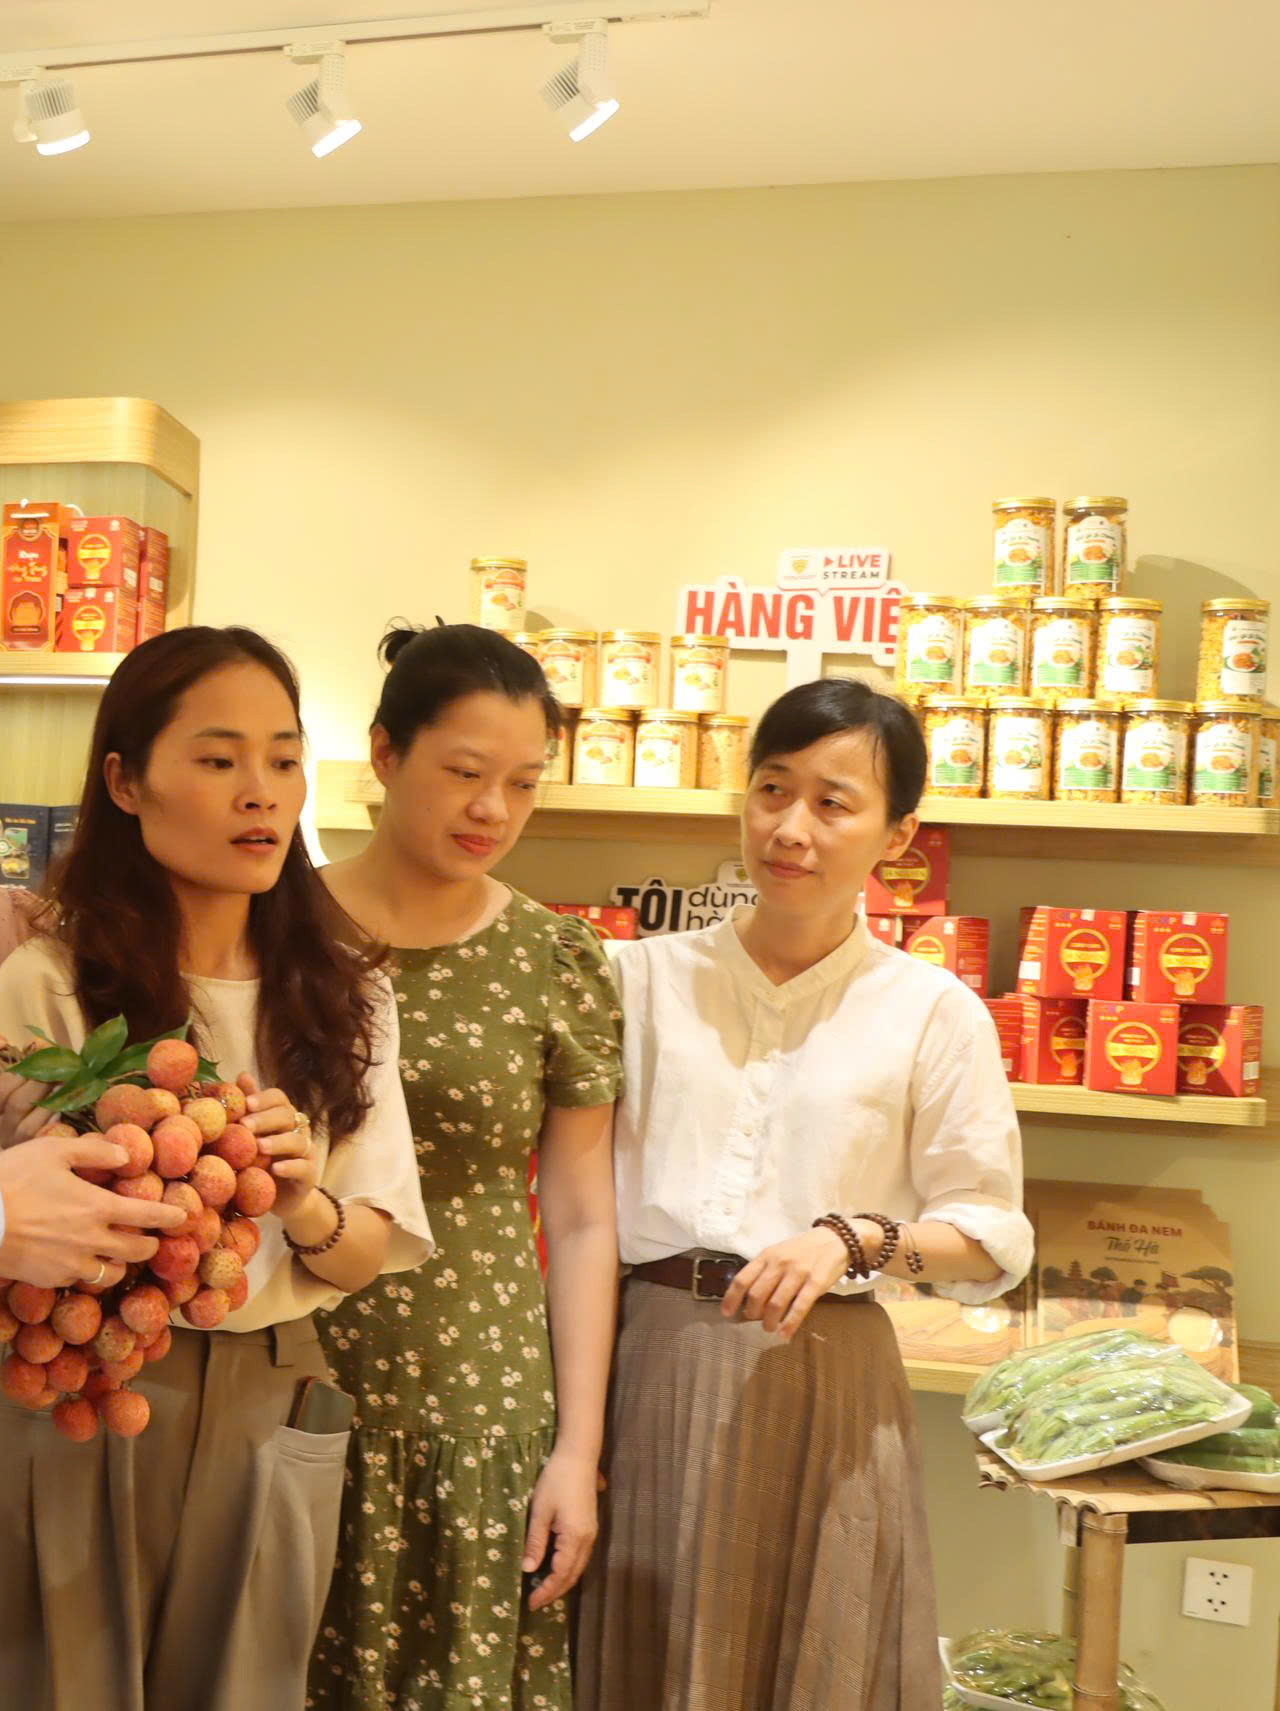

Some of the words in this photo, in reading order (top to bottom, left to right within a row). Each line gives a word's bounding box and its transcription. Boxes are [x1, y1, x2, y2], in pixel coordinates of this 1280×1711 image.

[838, 554, 881, 568] LIVE
[823, 570, 880, 580] STREAM
[685, 582, 815, 641] HÀNG
[617, 879, 683, 932] TÔI
[687, 887, 759, 908] dùn
[1151, 1225, 1183, 1238] NEM
